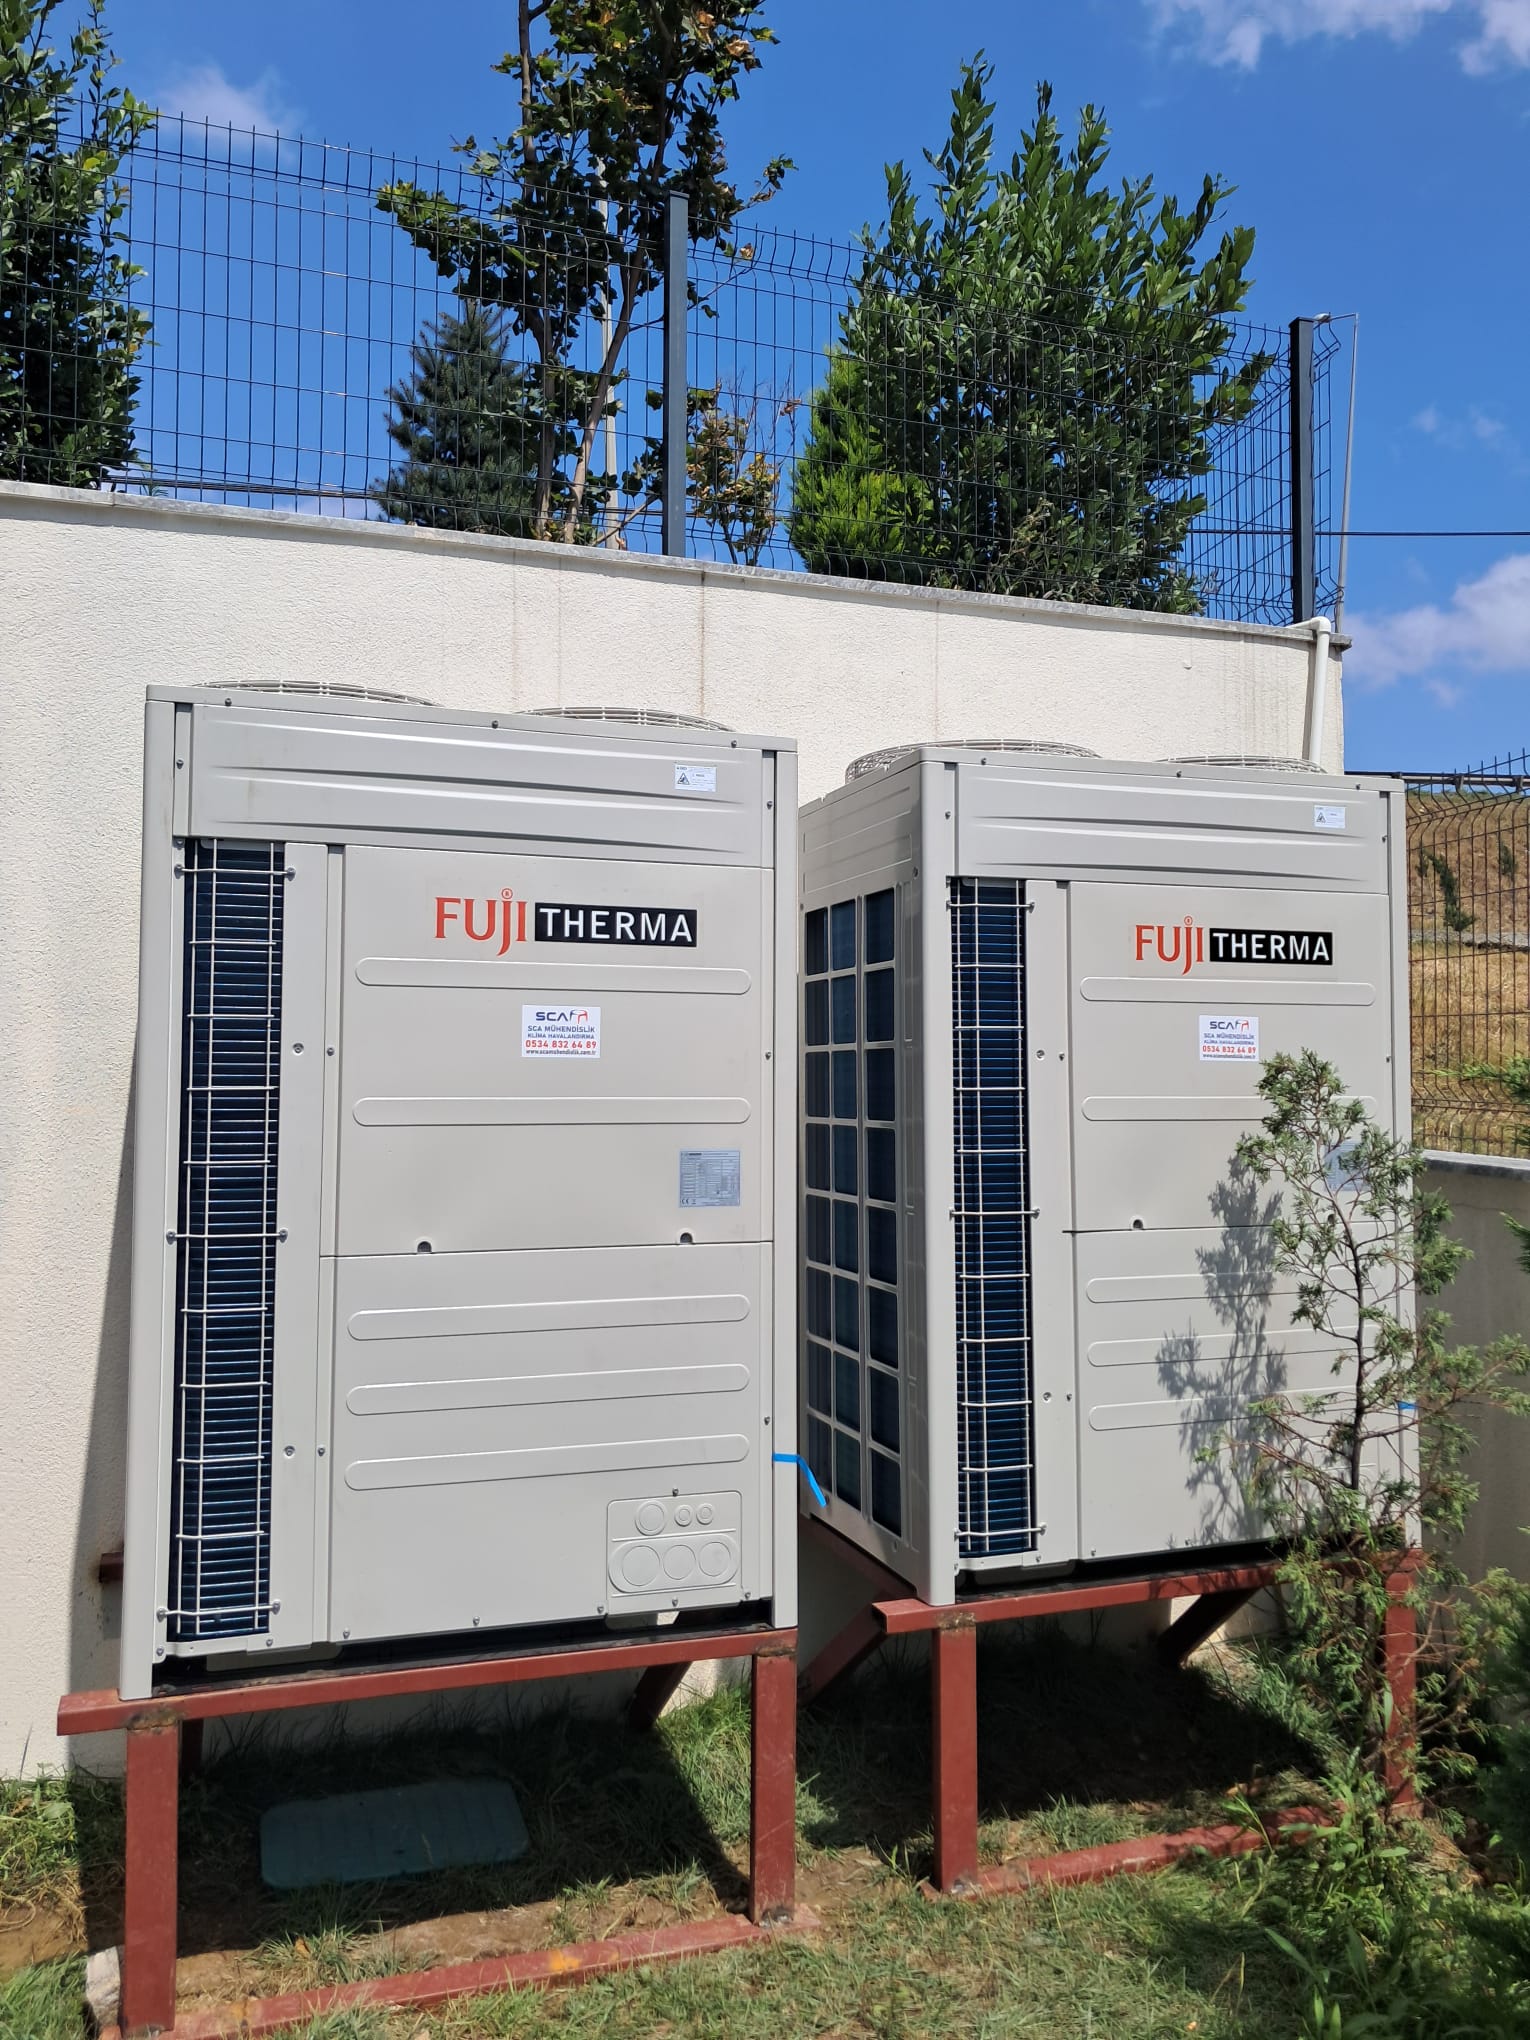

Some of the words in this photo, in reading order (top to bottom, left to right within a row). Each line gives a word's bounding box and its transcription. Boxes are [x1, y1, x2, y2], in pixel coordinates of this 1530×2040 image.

[434, 887, 528, 956] FUJI
[539, 907, 693, 943] THERMA
[1135, 915, 1204, 976] FUJI
[1212, 932, 1330, 961] THERMA
[525, 1040, 549, 1048] 0534
[551, 1040, 569, 1048] 832
[1202, 1045, 1220, 1053] 0534
